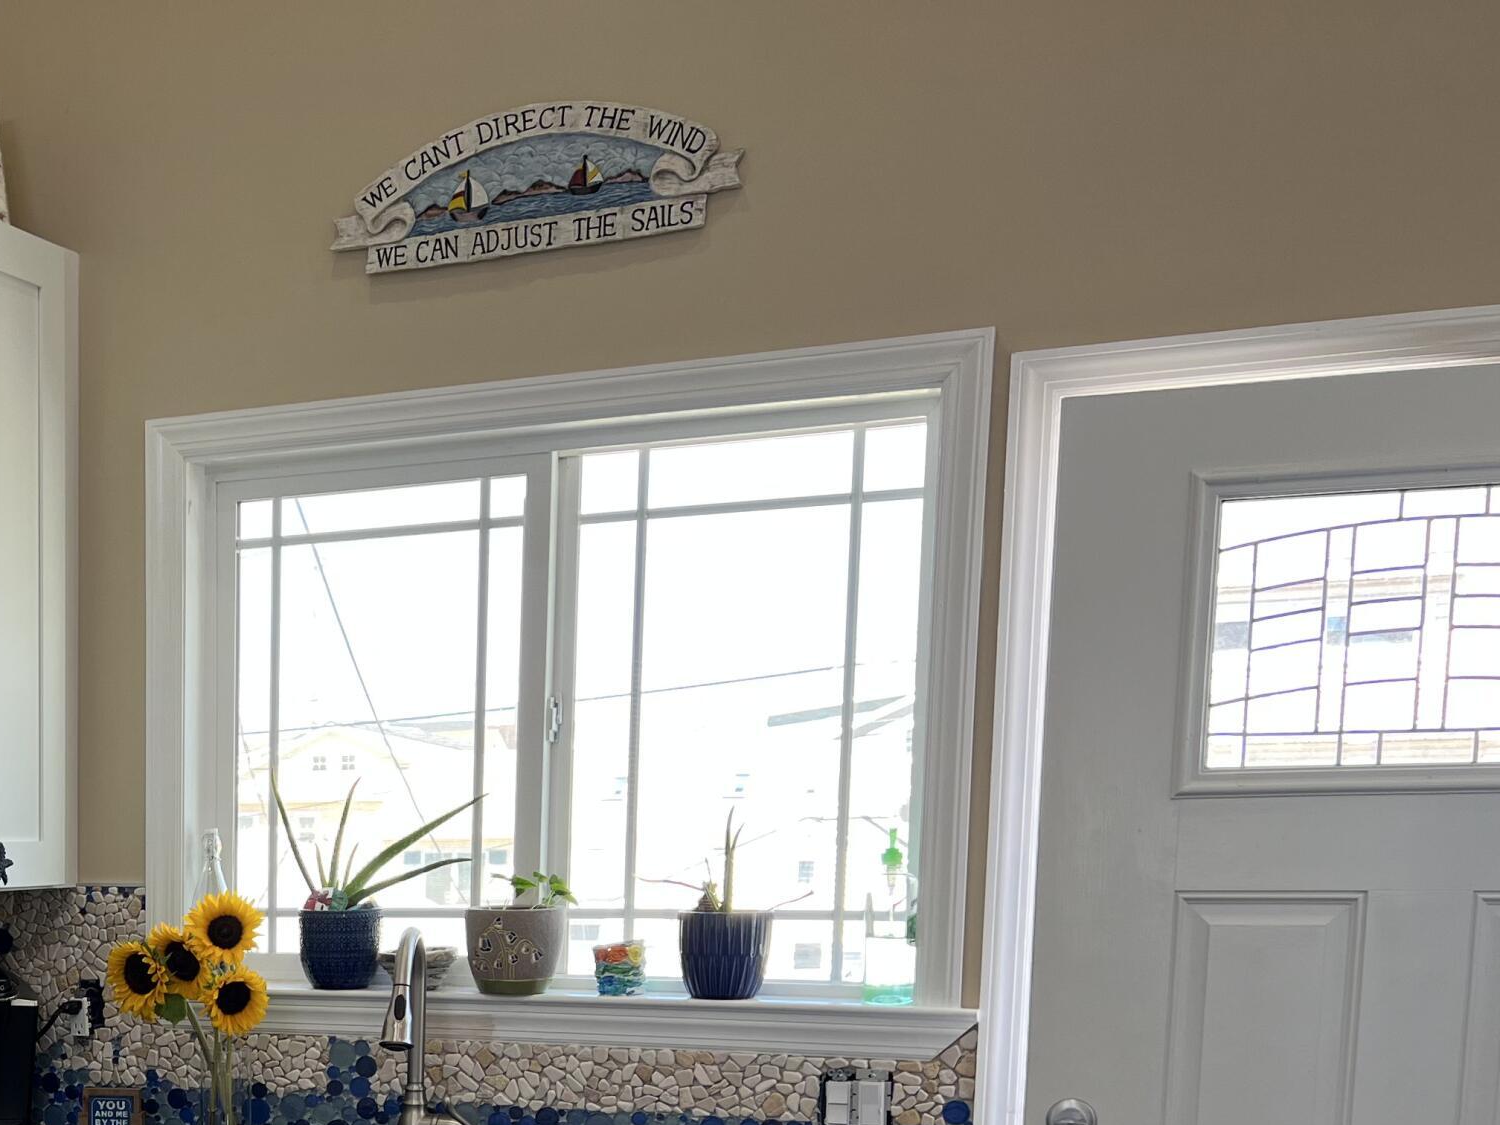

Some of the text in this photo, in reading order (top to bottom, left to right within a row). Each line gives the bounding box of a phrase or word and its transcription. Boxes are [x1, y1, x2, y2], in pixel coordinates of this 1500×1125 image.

[360, 105, 707, 210] WE CAN'T DIRECT THE WIND
[375, 200, 695, 269] WE CAN ADJUST THE SAILS
[94, 1110, 129, 1118] AND ME
[96, 1100, 126, 1110] YOU
